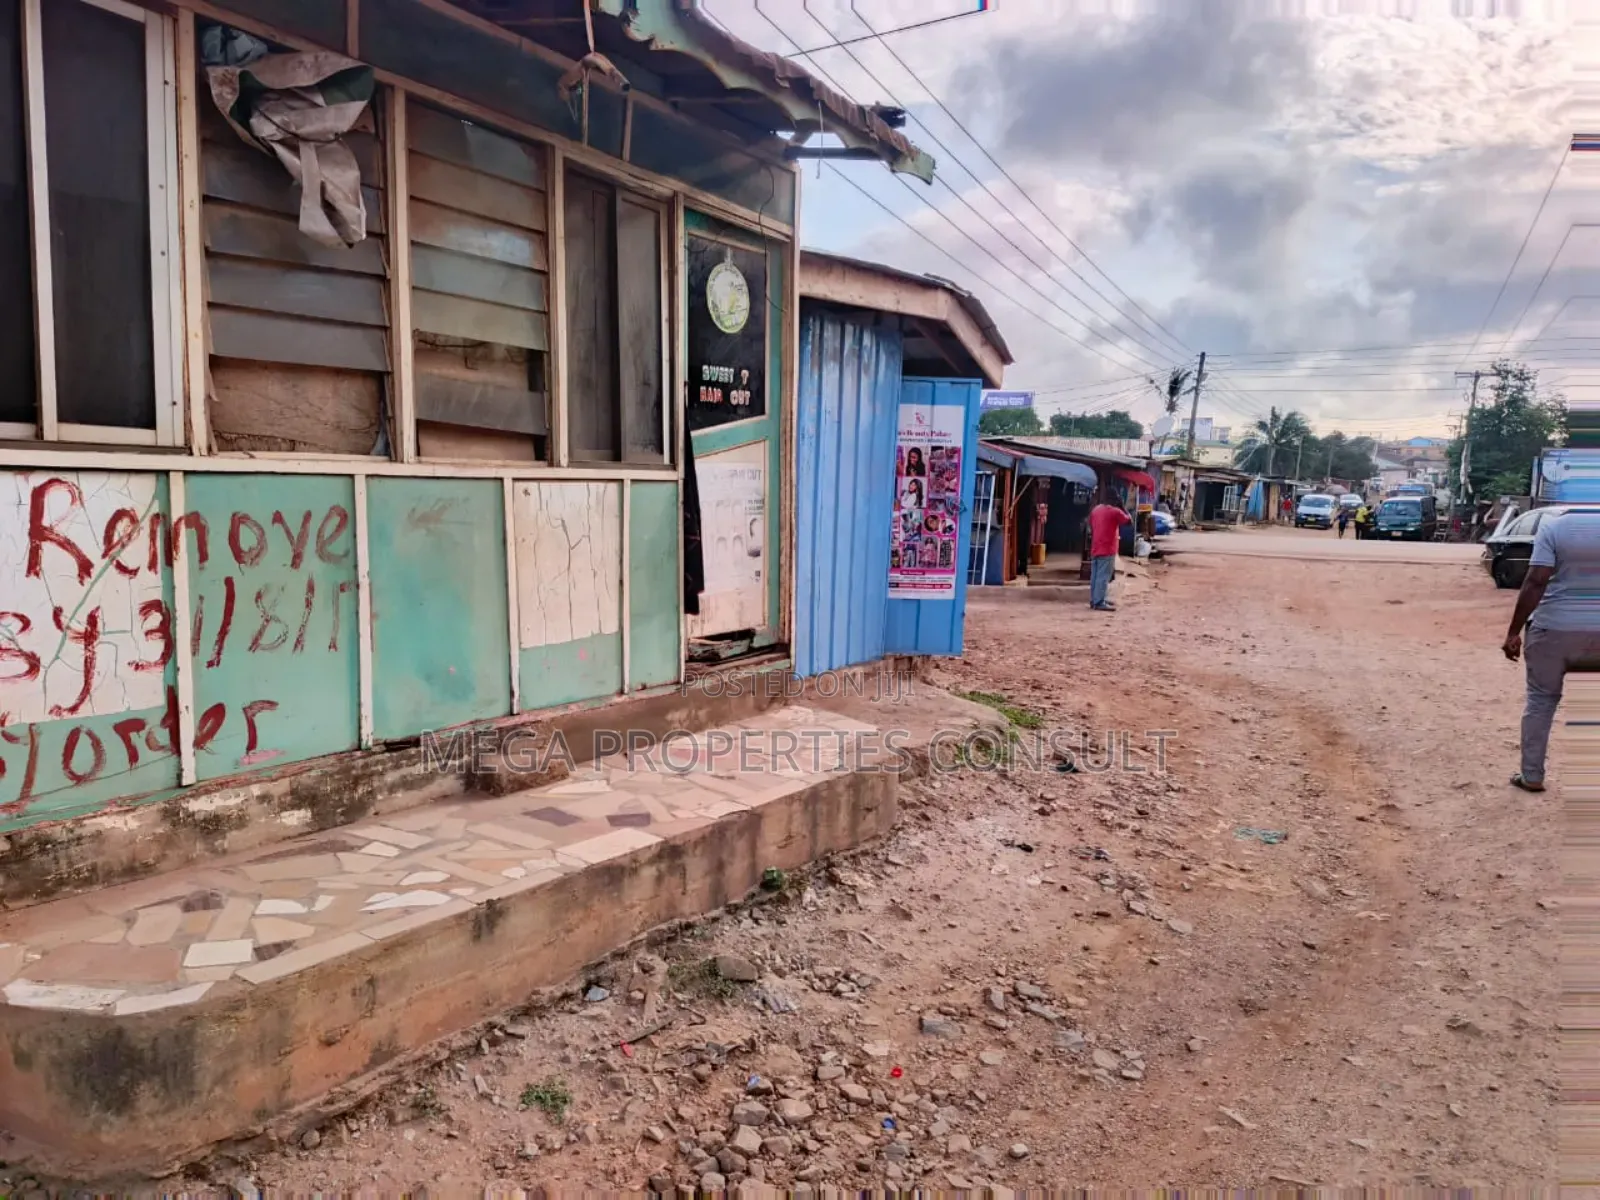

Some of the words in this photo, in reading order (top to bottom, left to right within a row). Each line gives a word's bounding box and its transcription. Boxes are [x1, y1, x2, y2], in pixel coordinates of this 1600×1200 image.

[702, 364, 734, 384] SWEET
[730, 389, 751, 406] CUT
[26, 477, 350, 587] Remove
